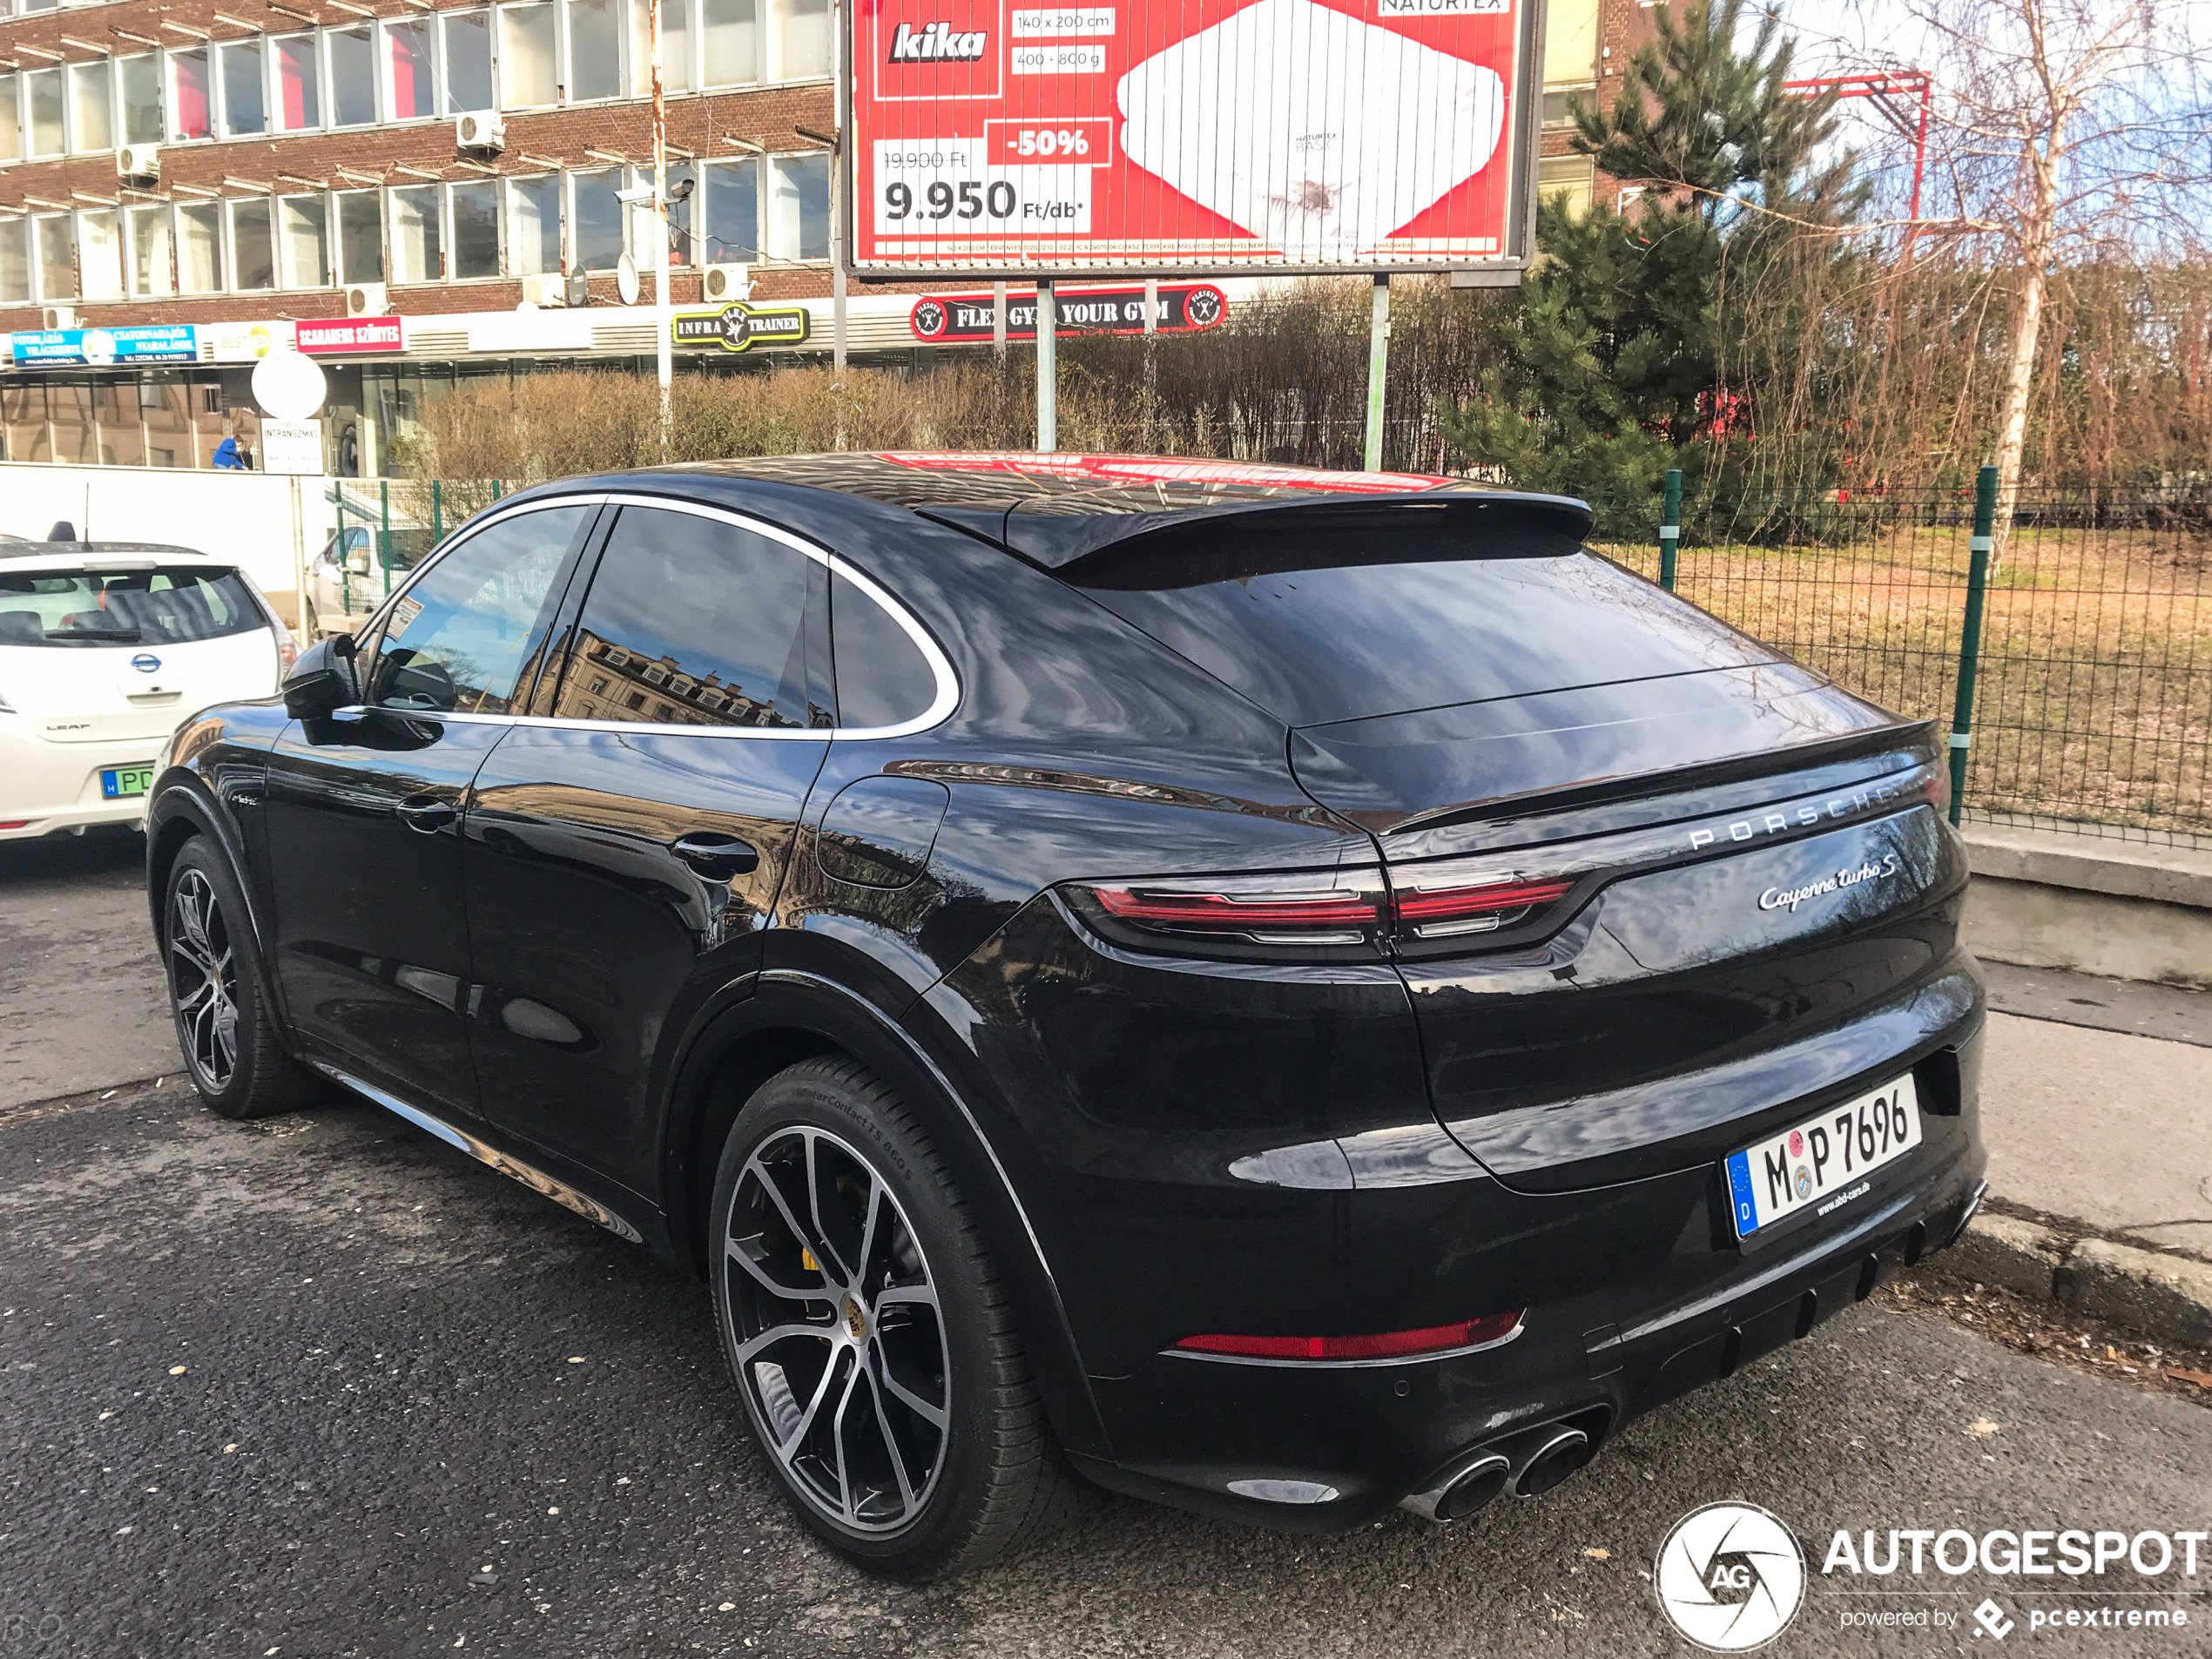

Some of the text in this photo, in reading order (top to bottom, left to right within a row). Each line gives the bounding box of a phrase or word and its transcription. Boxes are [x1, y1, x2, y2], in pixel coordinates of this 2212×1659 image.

[1382, 0, 1501, 11] NATURTEX
[1017, 17, 1041, 29] 140
[1055, 16, 1083, 28] 200
[1087, 17, 1109, 27] cm
[889, 21, 988, 64] kika
[1017, 53, 1044, 65] 400
[1059, 52, 1087, 65] 800
[1090, 54, 1100, 67] g
[1008, 130, 1089, 156] -50%
[884, 152, 968, 169] 19.900 Ft
[885, 180, 1016, 220] 9.950
[721, 307, 748, 324] FLEX
[1061, 302, 1118, 323] YOUR
[1123, 300, 1169, 321] GYM
[678, 317, 799, 334] INFRA TRAINER
[220, 335, 267, 348] BESTED
[1689, 787, 1900, 851] PORSCHE
[1759, 877, 1838, 912] Cayenne
[1880, 853, 1896, 879] S
[869, 1122, 882, 1142] TS
[883, 1141, 906, 1170] 860
[1764, 1089, 1908, 1210] M P 7696
[1817, 1181, 1871, 1217] www.abd-cars.de
[1741, 1203, 1750, 1220] D
